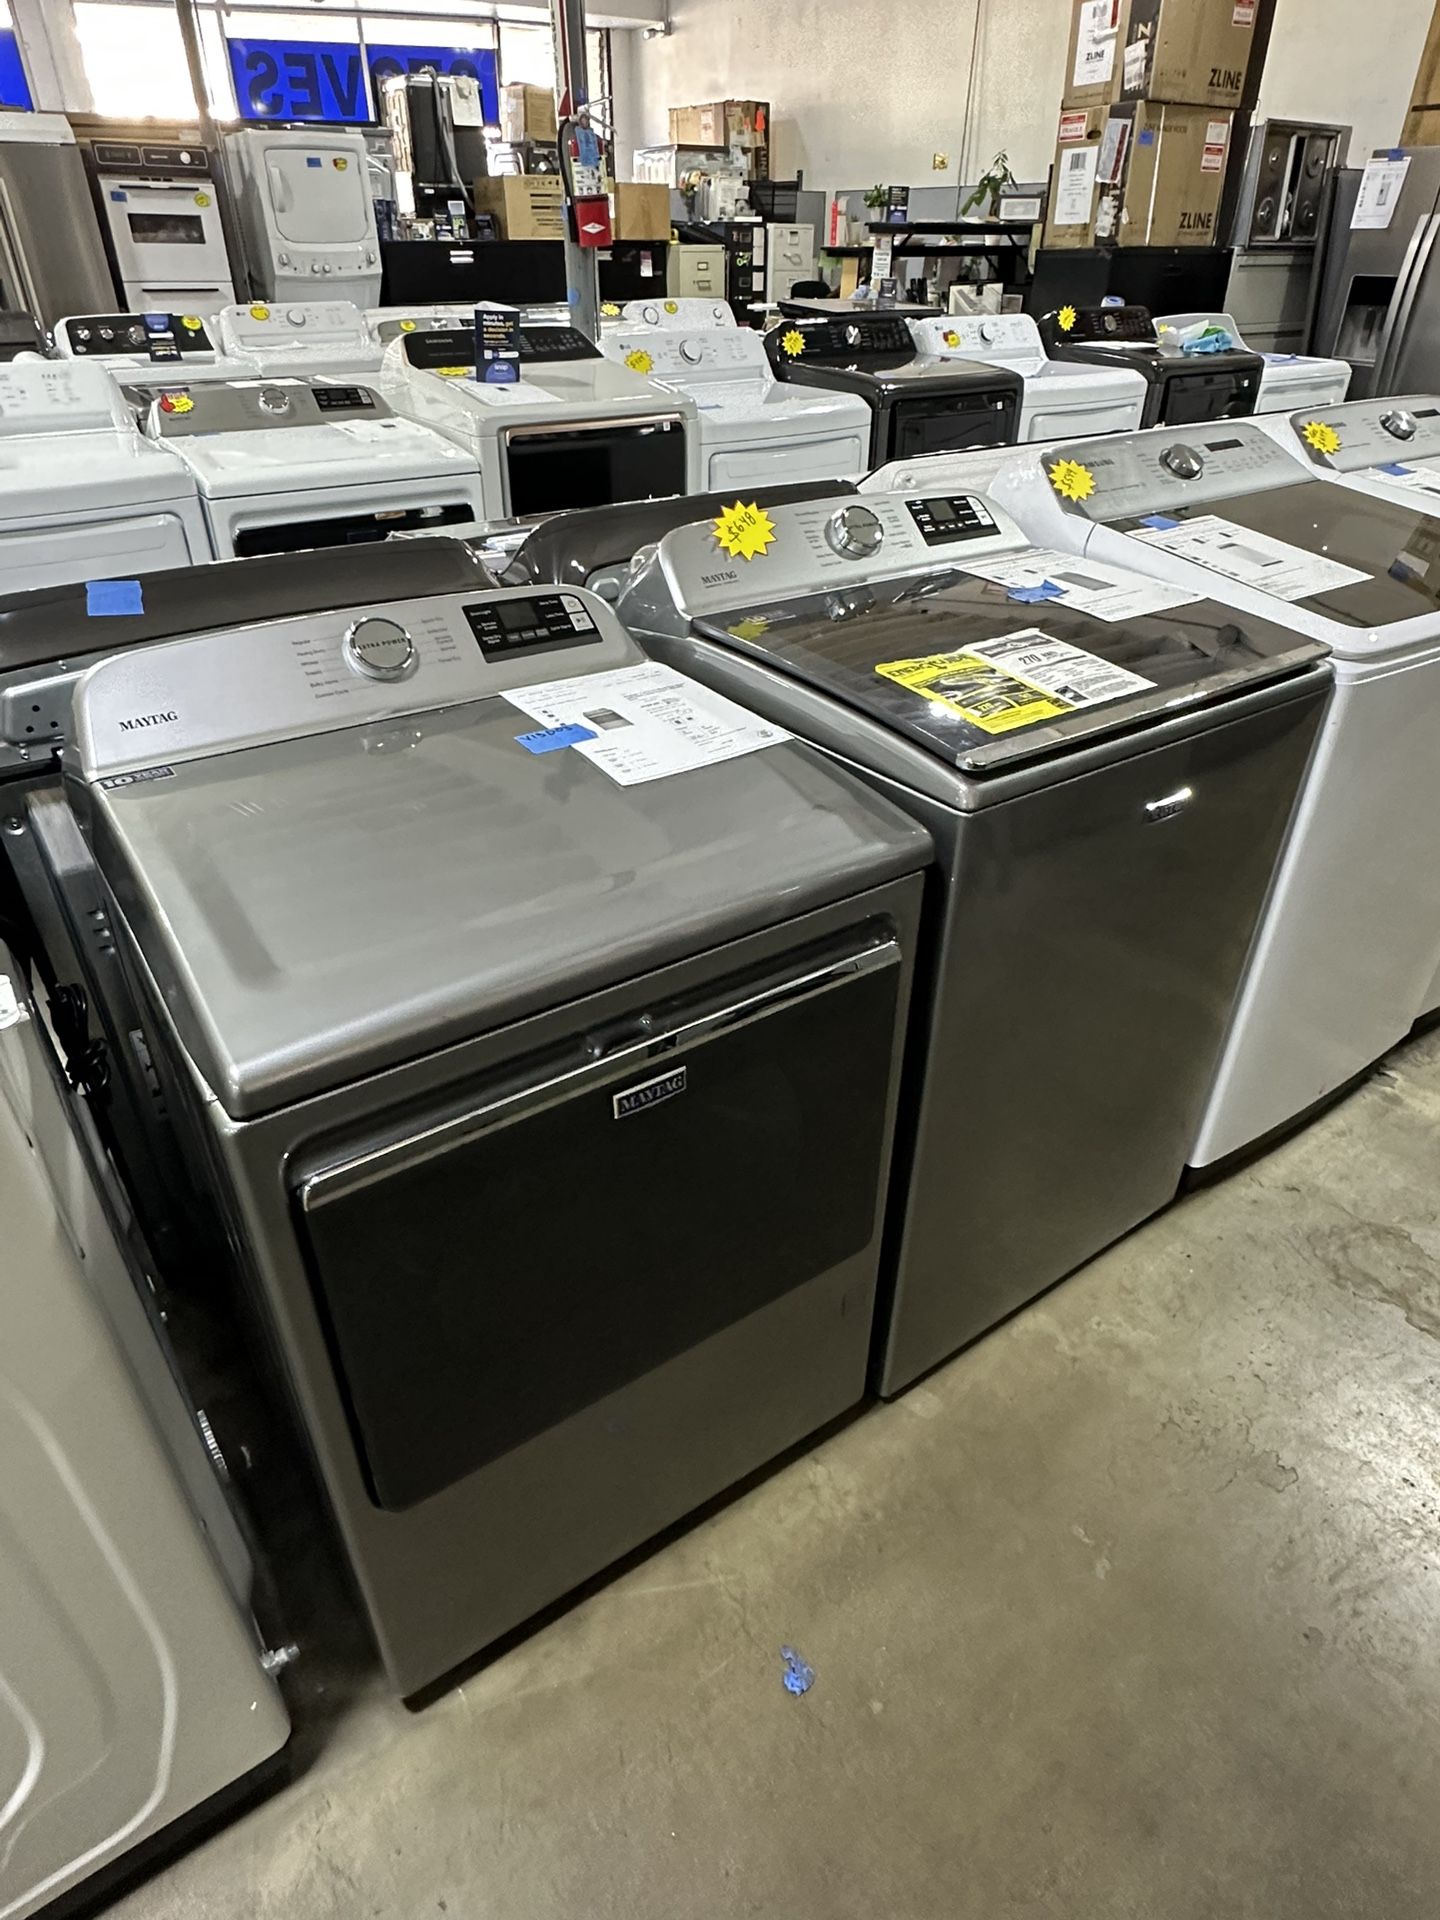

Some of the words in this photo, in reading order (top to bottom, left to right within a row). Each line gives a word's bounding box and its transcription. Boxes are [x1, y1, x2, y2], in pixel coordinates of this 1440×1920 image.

[1086, 49, 1105, 61] ZLINE
[1208, 68, 1243, 91] ZLINE
[1179, 212, 1213, 230] ZLINE
[727, 511, 757, 544] $648
[701, 570, 738, 586] MAYTAG
[1019, 653, 1039, 666] 270
[119, 710, 179, 733] MAYTAG
[101, 776, 134, 790] 10
[620, 1075, 684, 1112] MAYTAG
